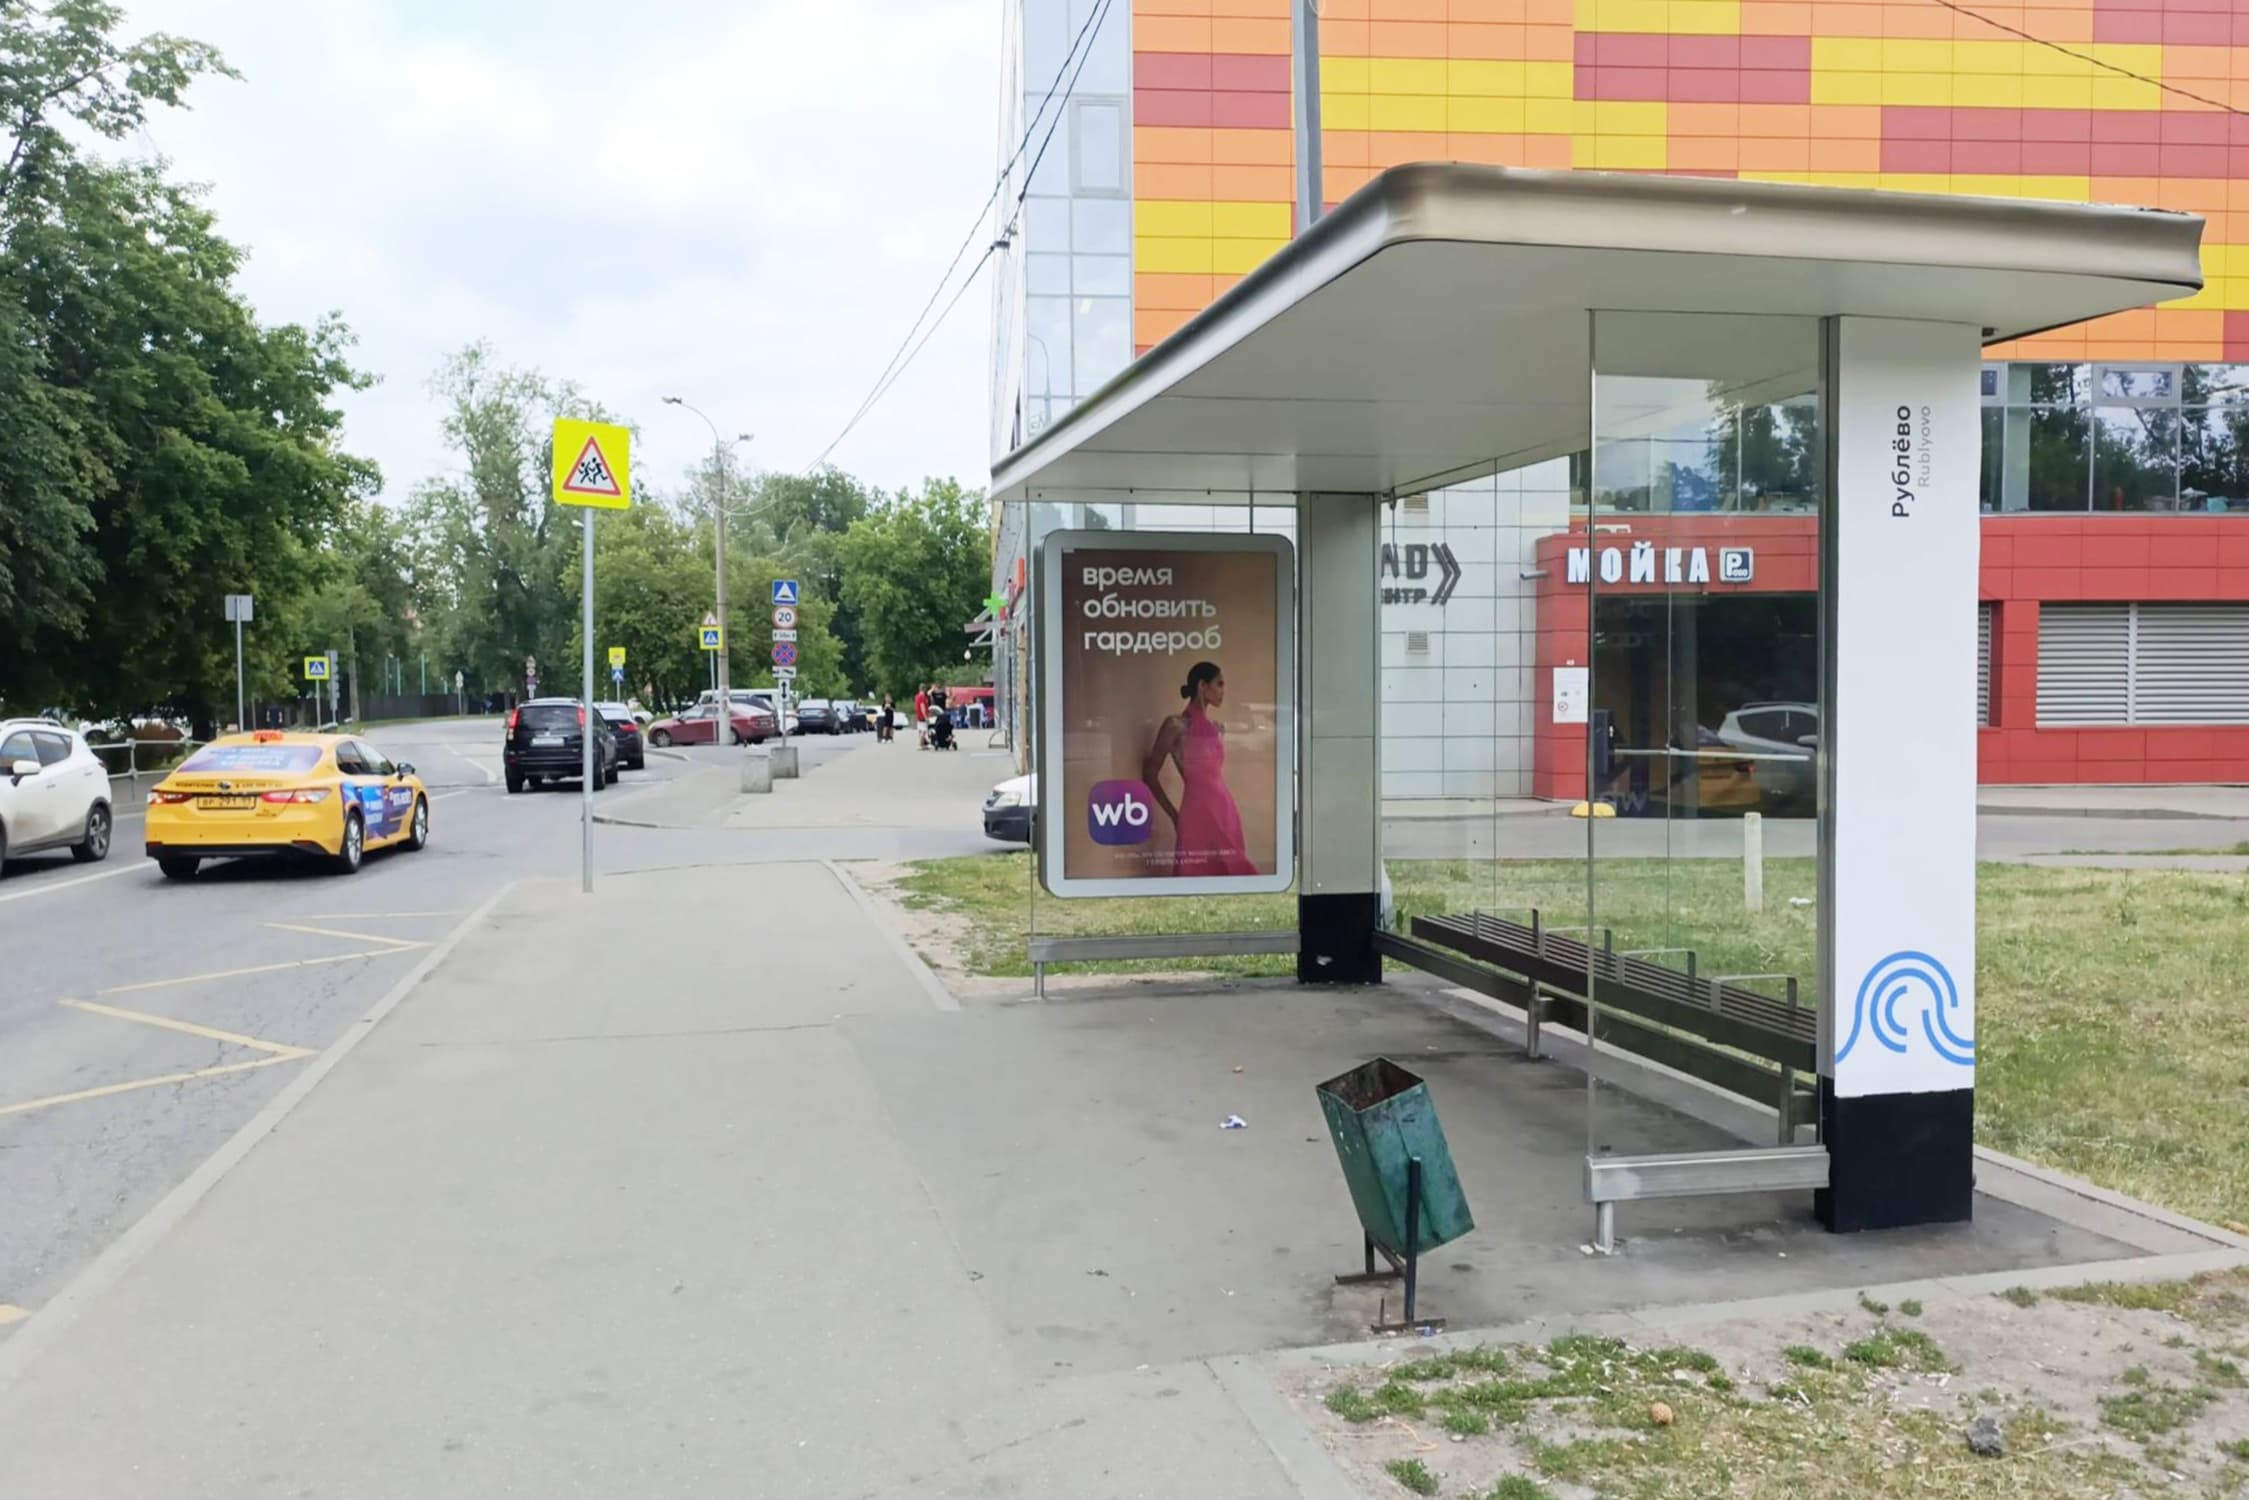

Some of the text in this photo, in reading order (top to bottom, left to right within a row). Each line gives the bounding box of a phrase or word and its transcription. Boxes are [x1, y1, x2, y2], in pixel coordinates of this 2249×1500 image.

[1892, 405, 1915, 517] Рублёво
[1918, 406, 1933, 488] Rublyovo
[1567, 540, 1710, 583] МОЙКА
[1083, 566, 1173, 592] время
[778, 612, 792, 622] 20
[1083, 592, 1217, 618] обновить
[1084, 625, 1222, 657] гардероб
[1092, 793, 1149, 826] wb
